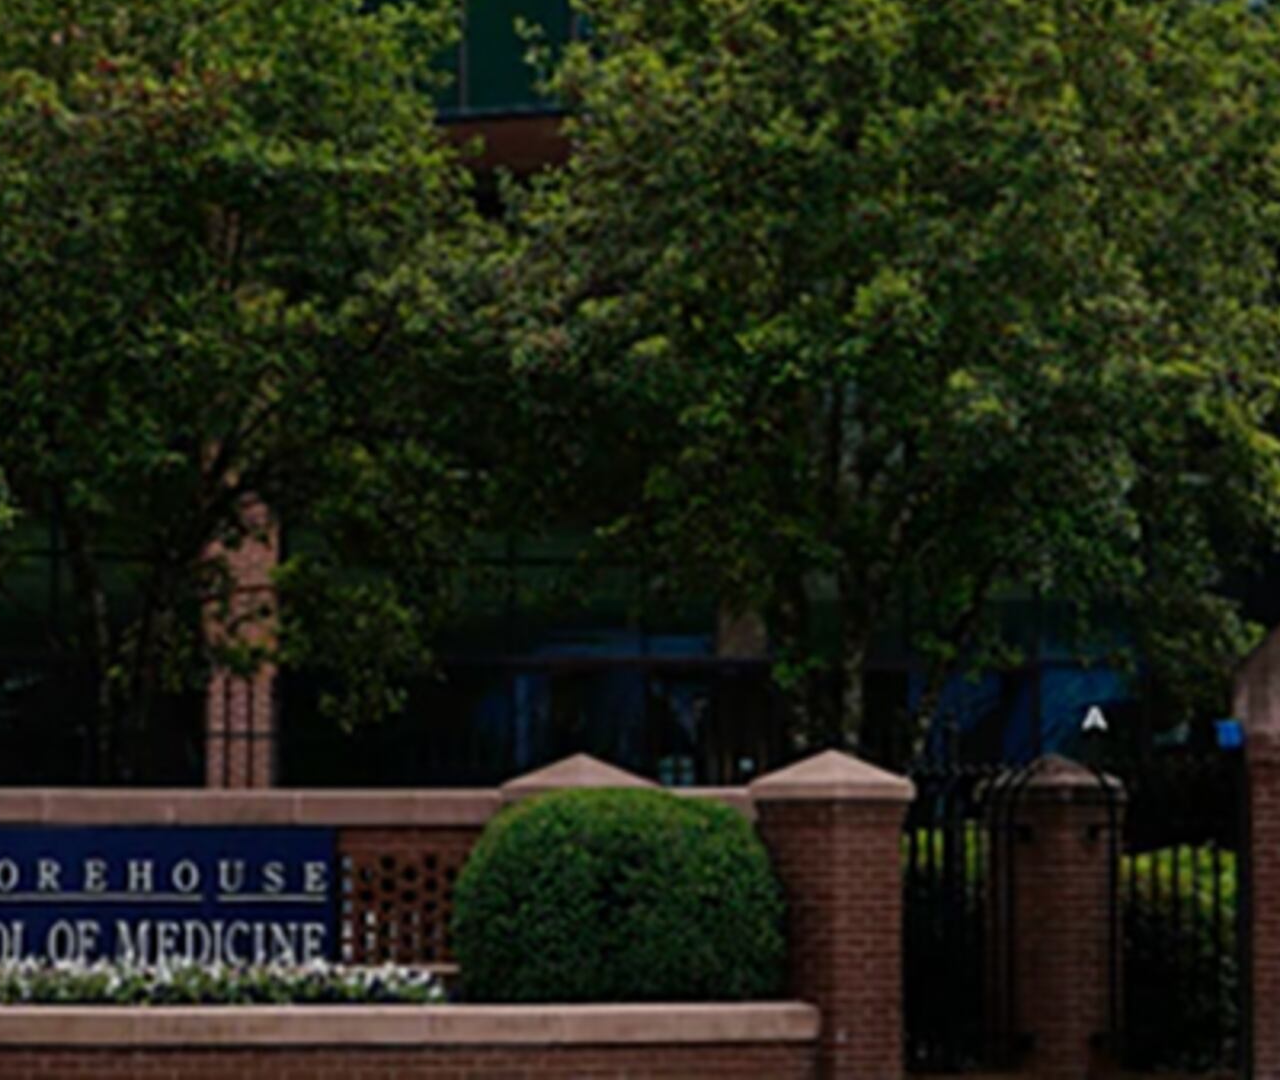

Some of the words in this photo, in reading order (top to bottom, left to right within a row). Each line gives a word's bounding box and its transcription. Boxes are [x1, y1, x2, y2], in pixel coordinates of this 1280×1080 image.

[1081, 705, 1109, 731] A
[46, 920, 101, 966] OF
[117, 920, 327, 967] MEDICINE
